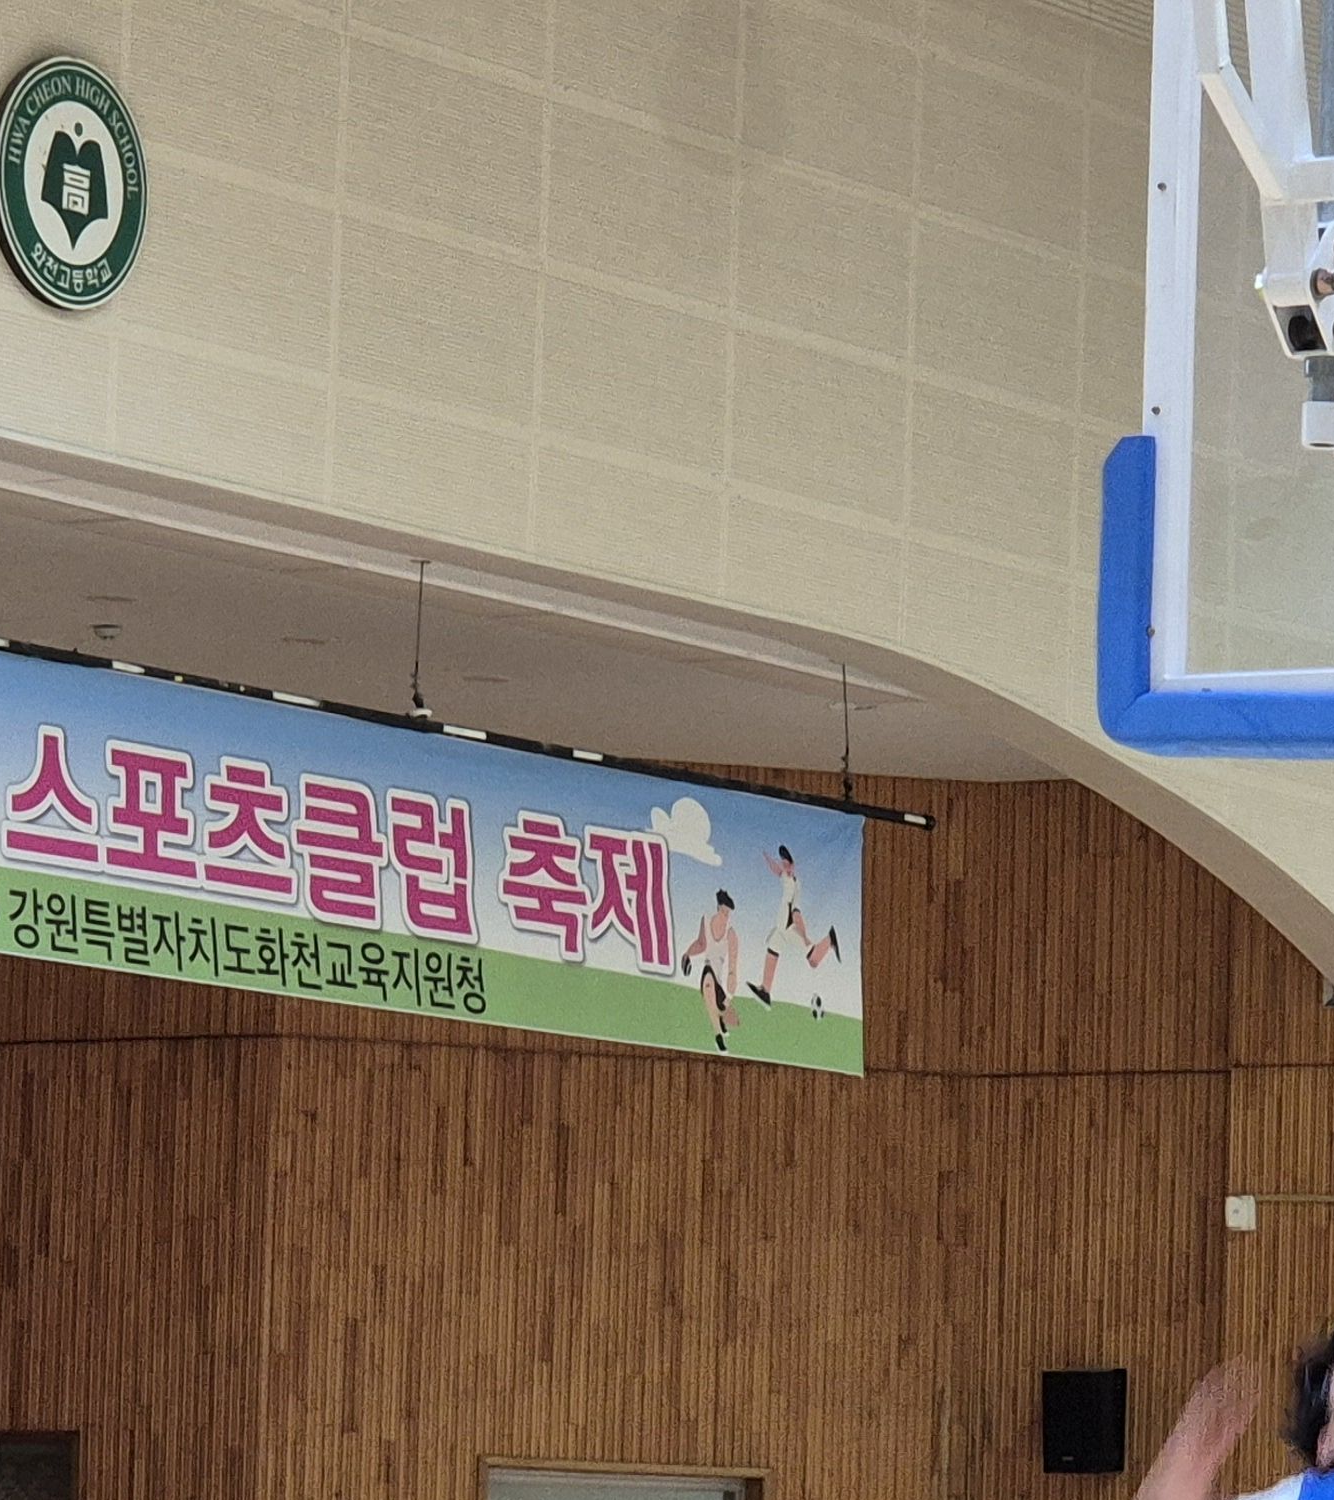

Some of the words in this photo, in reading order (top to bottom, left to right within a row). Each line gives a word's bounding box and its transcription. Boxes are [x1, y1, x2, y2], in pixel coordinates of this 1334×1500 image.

[7, 116, 32, 165] HWA
[25, 75, 72, 115] CHEON
[75, 76, 111, 116] HIGH
[108, 110, 140, 201] SCHOOL
[5, 733, 473, 936] 스포츠클럽
[503, 817, 671, 967] 축제
[9, 888, 488, 1016] 강원특별자치도화천교육지원청
